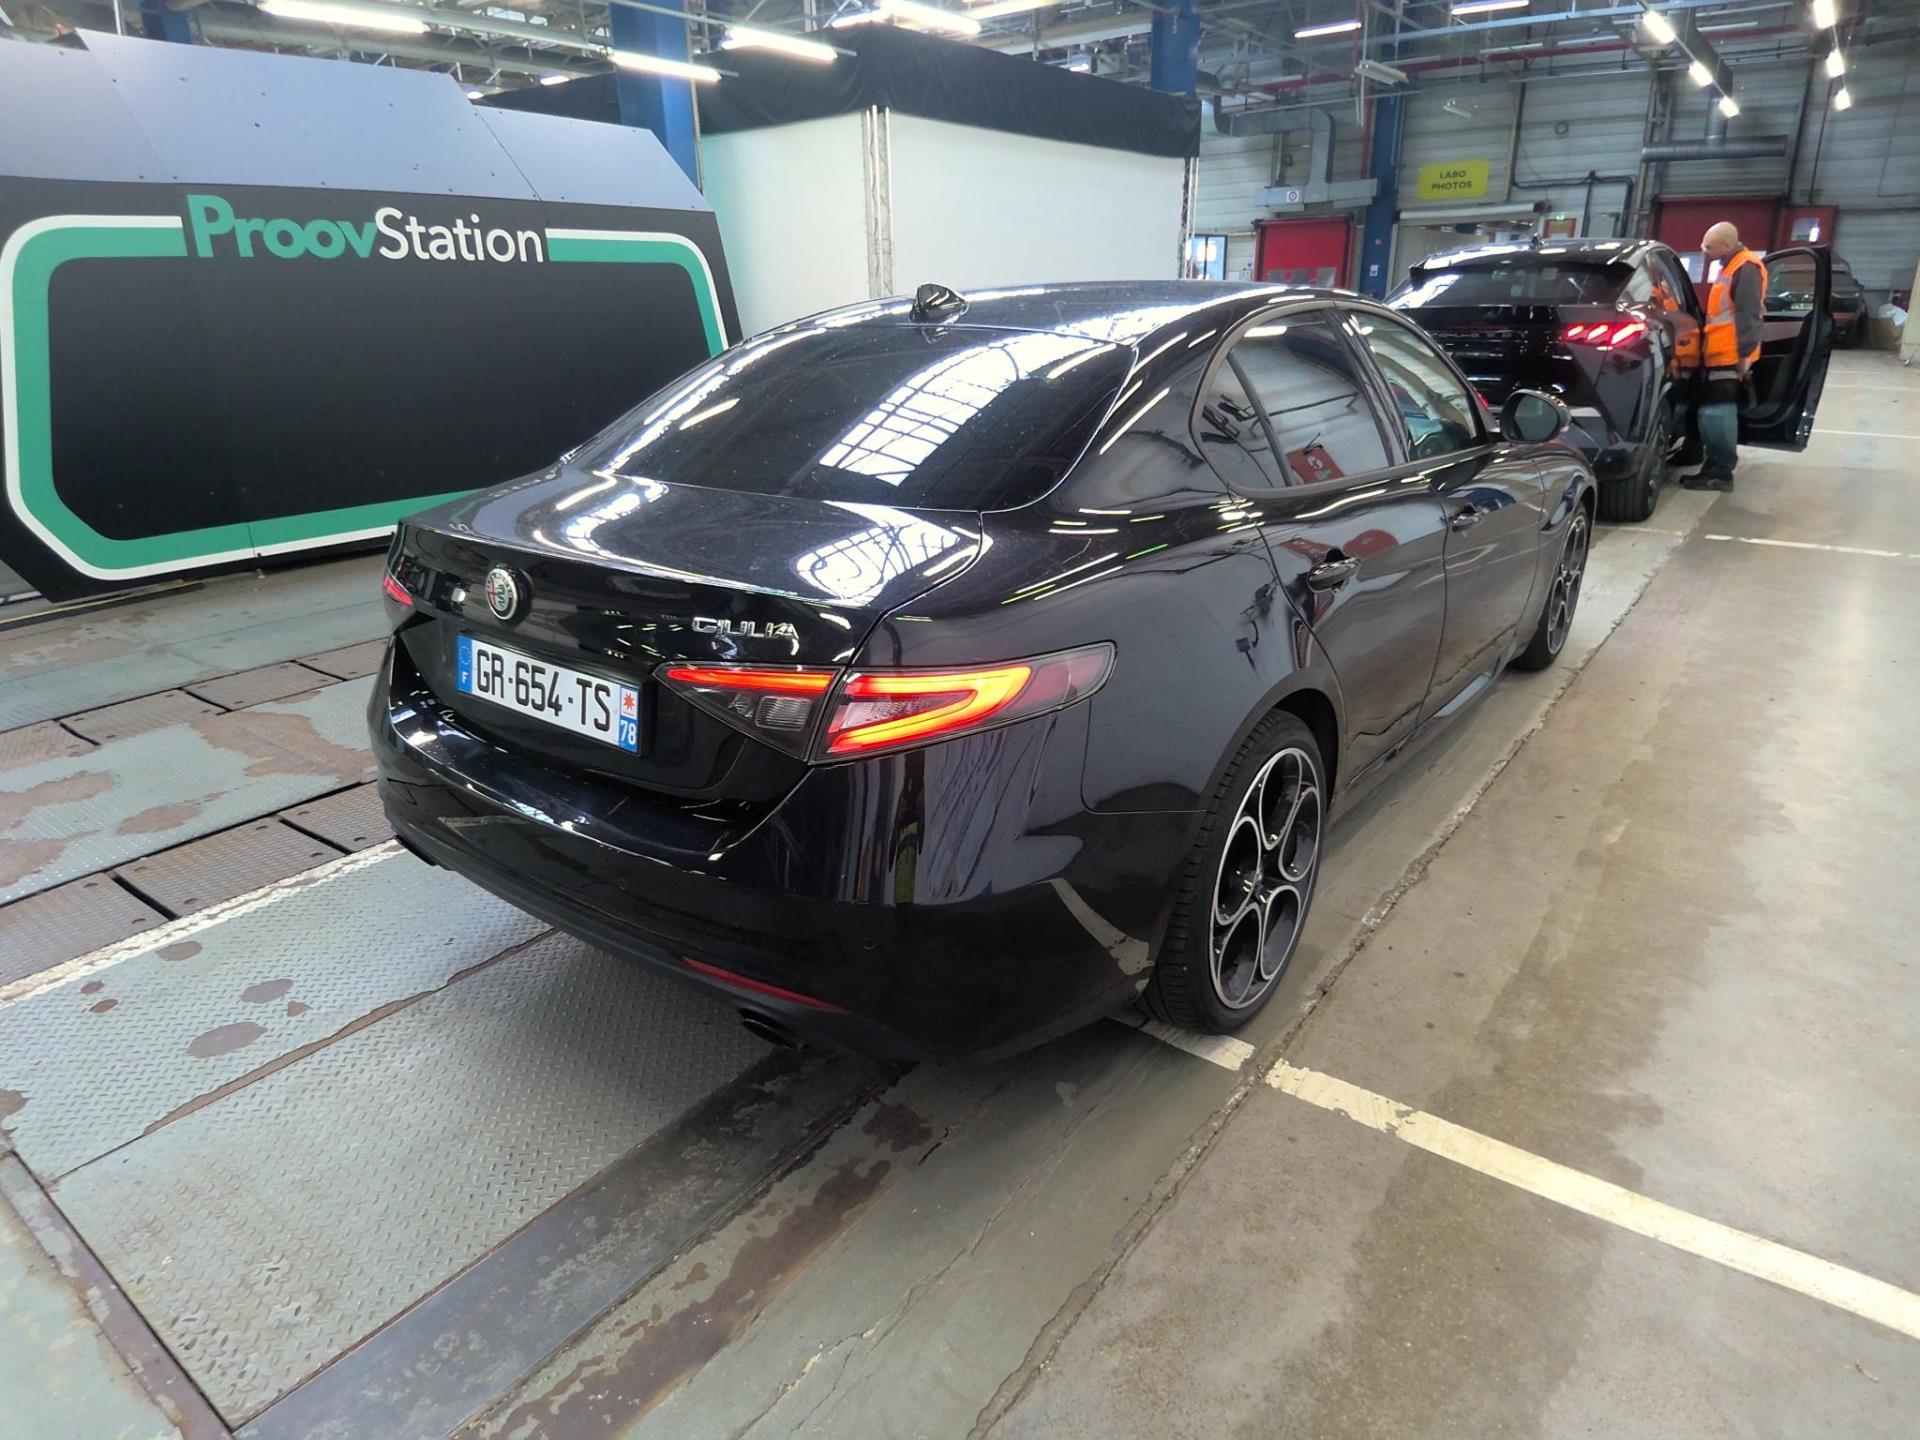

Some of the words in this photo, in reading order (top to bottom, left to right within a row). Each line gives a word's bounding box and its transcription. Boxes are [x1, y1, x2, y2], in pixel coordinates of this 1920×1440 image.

[1431, 181, 1473, 191] PHOTOS
[1440, 170, 1467, 179] LABO
[186, 194, 544, 263] ProovStation
[691, 616, 800, 639] GIULIA
[461, 672, 468, 684] F
[476, 649, 612, 732] GR-654-TS
[619, 720, 637, 745] 78
